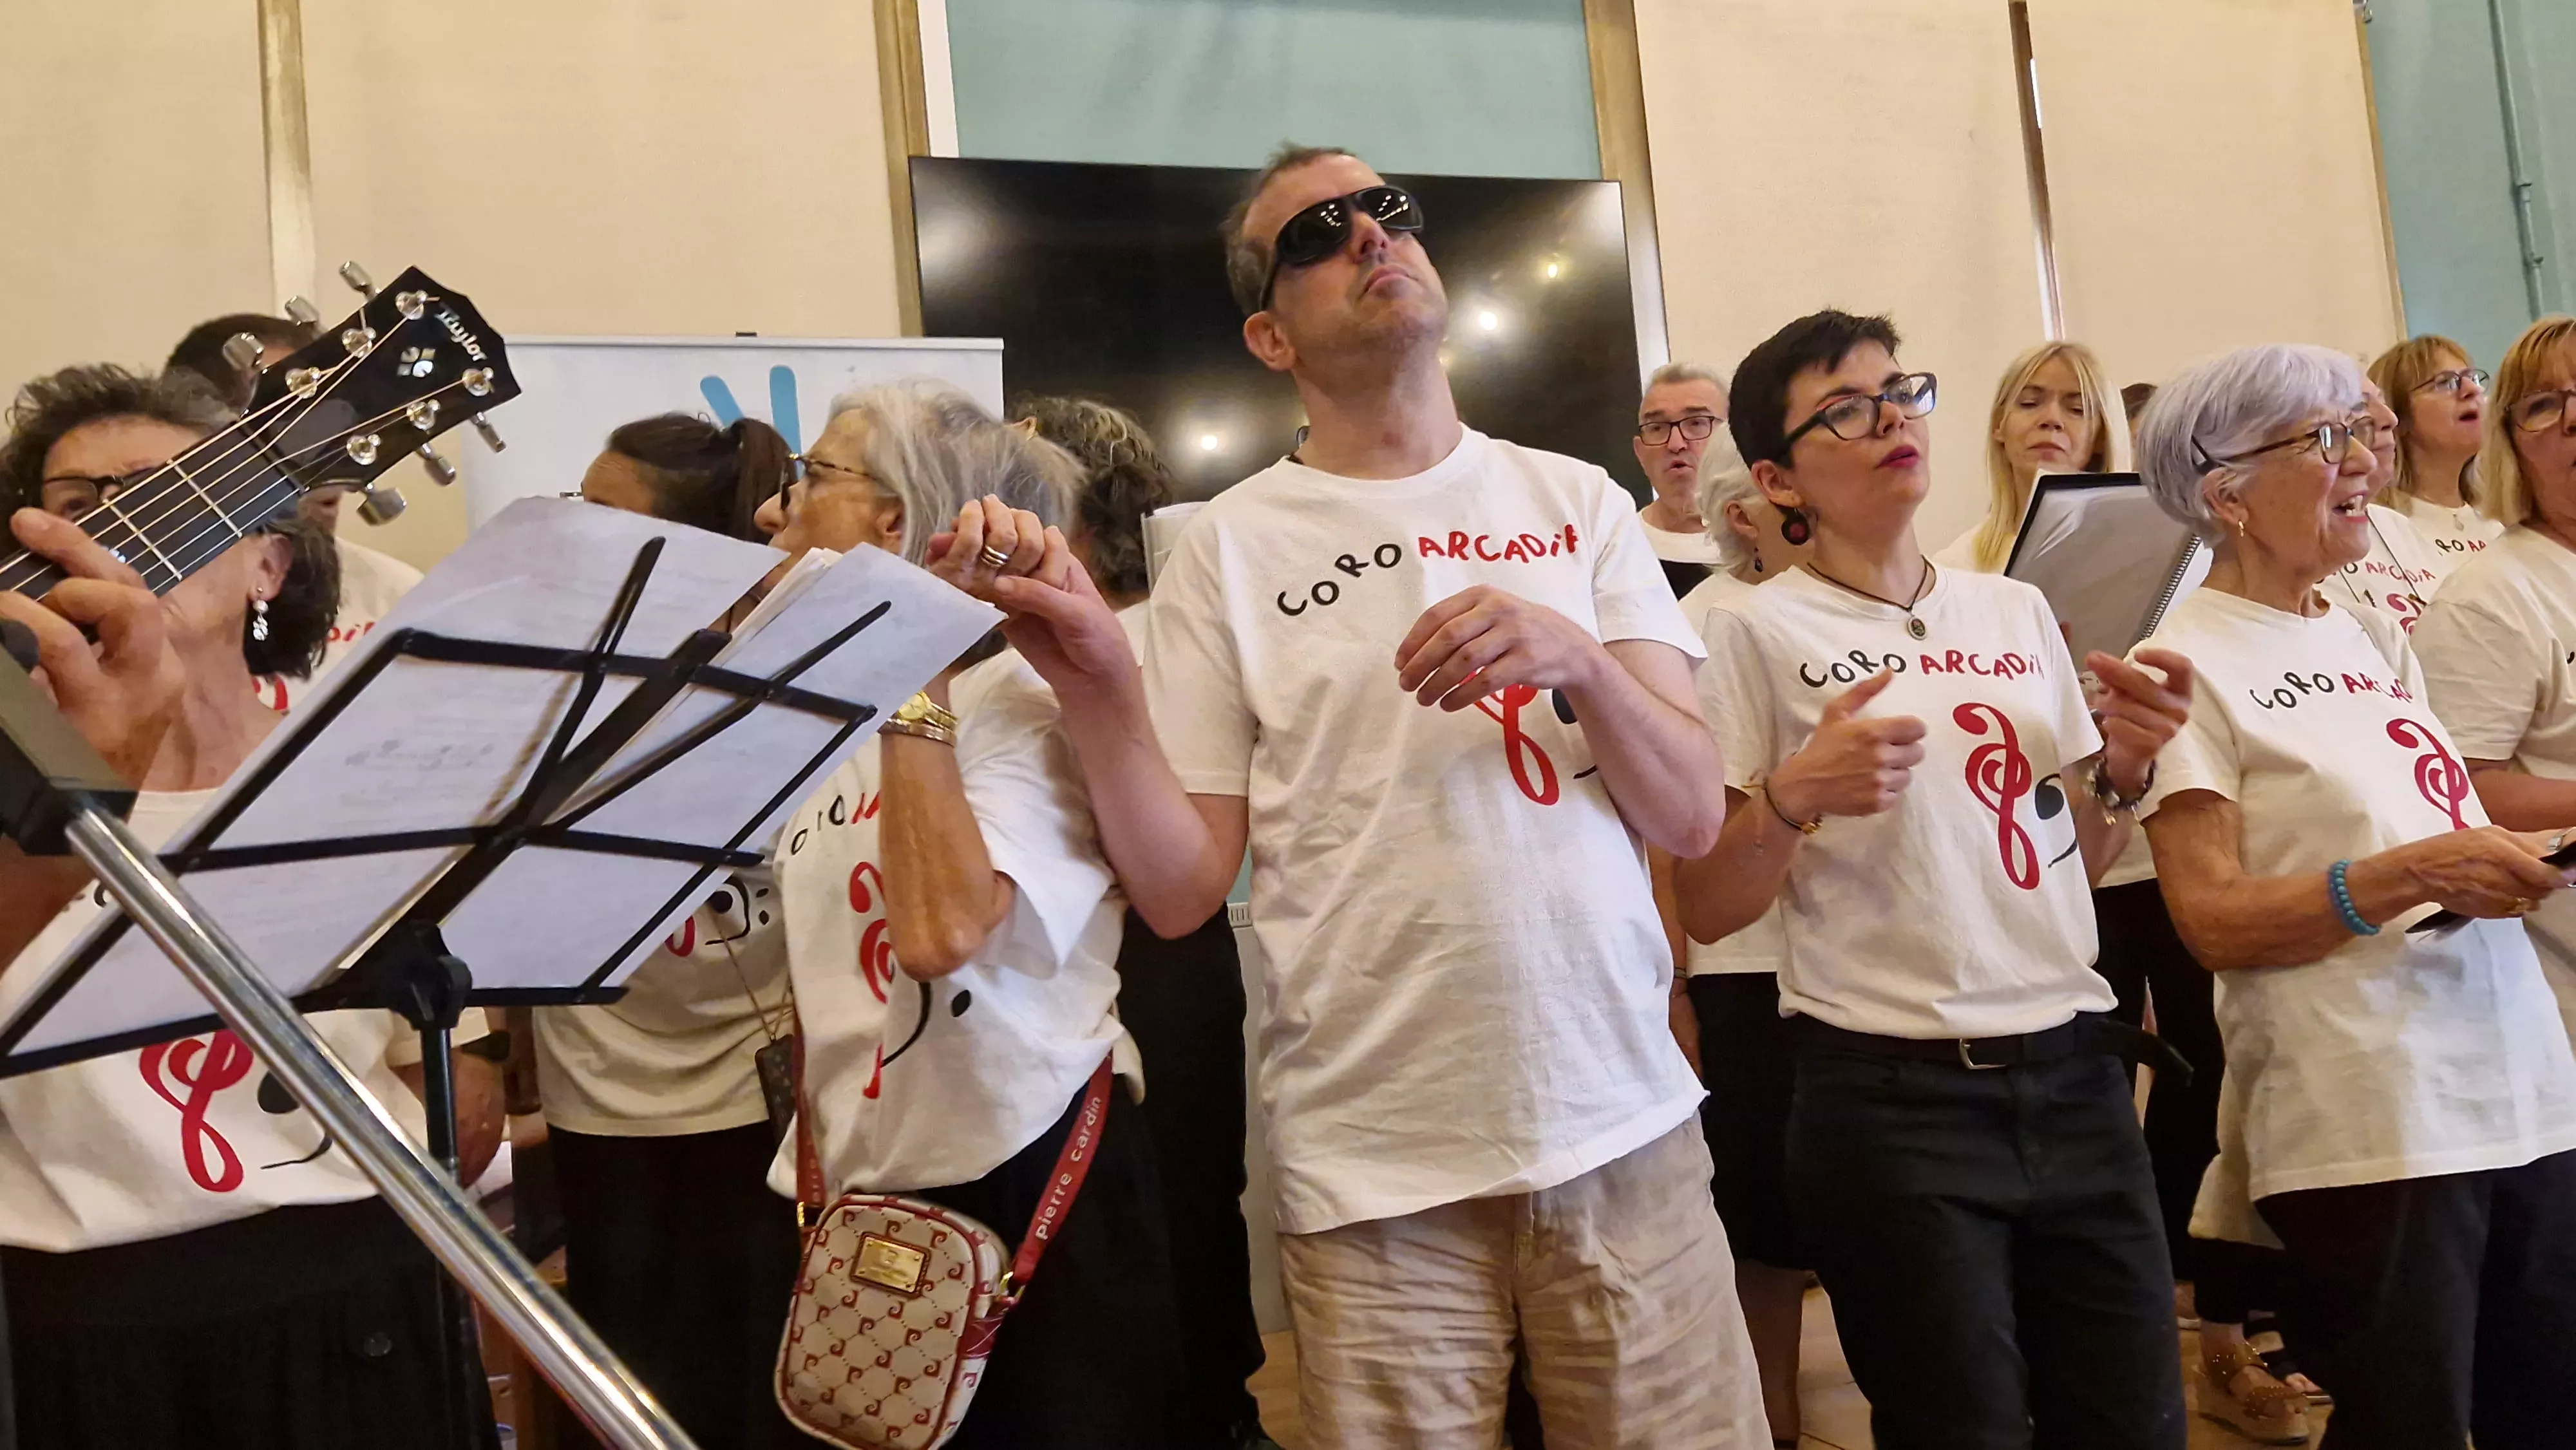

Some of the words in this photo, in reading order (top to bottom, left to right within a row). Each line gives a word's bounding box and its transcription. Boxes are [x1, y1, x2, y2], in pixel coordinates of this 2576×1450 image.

[434, 303, 488, 361] Taylor
[1277, 543, 1402, 616] CORO
[1799, 649, 1907, 688] CORO
[2249, 672, 2335, 710] CORO
[1035, 1172, 1073, 1241] pierre
[1070, 1096, 1102, 1162] cardin
